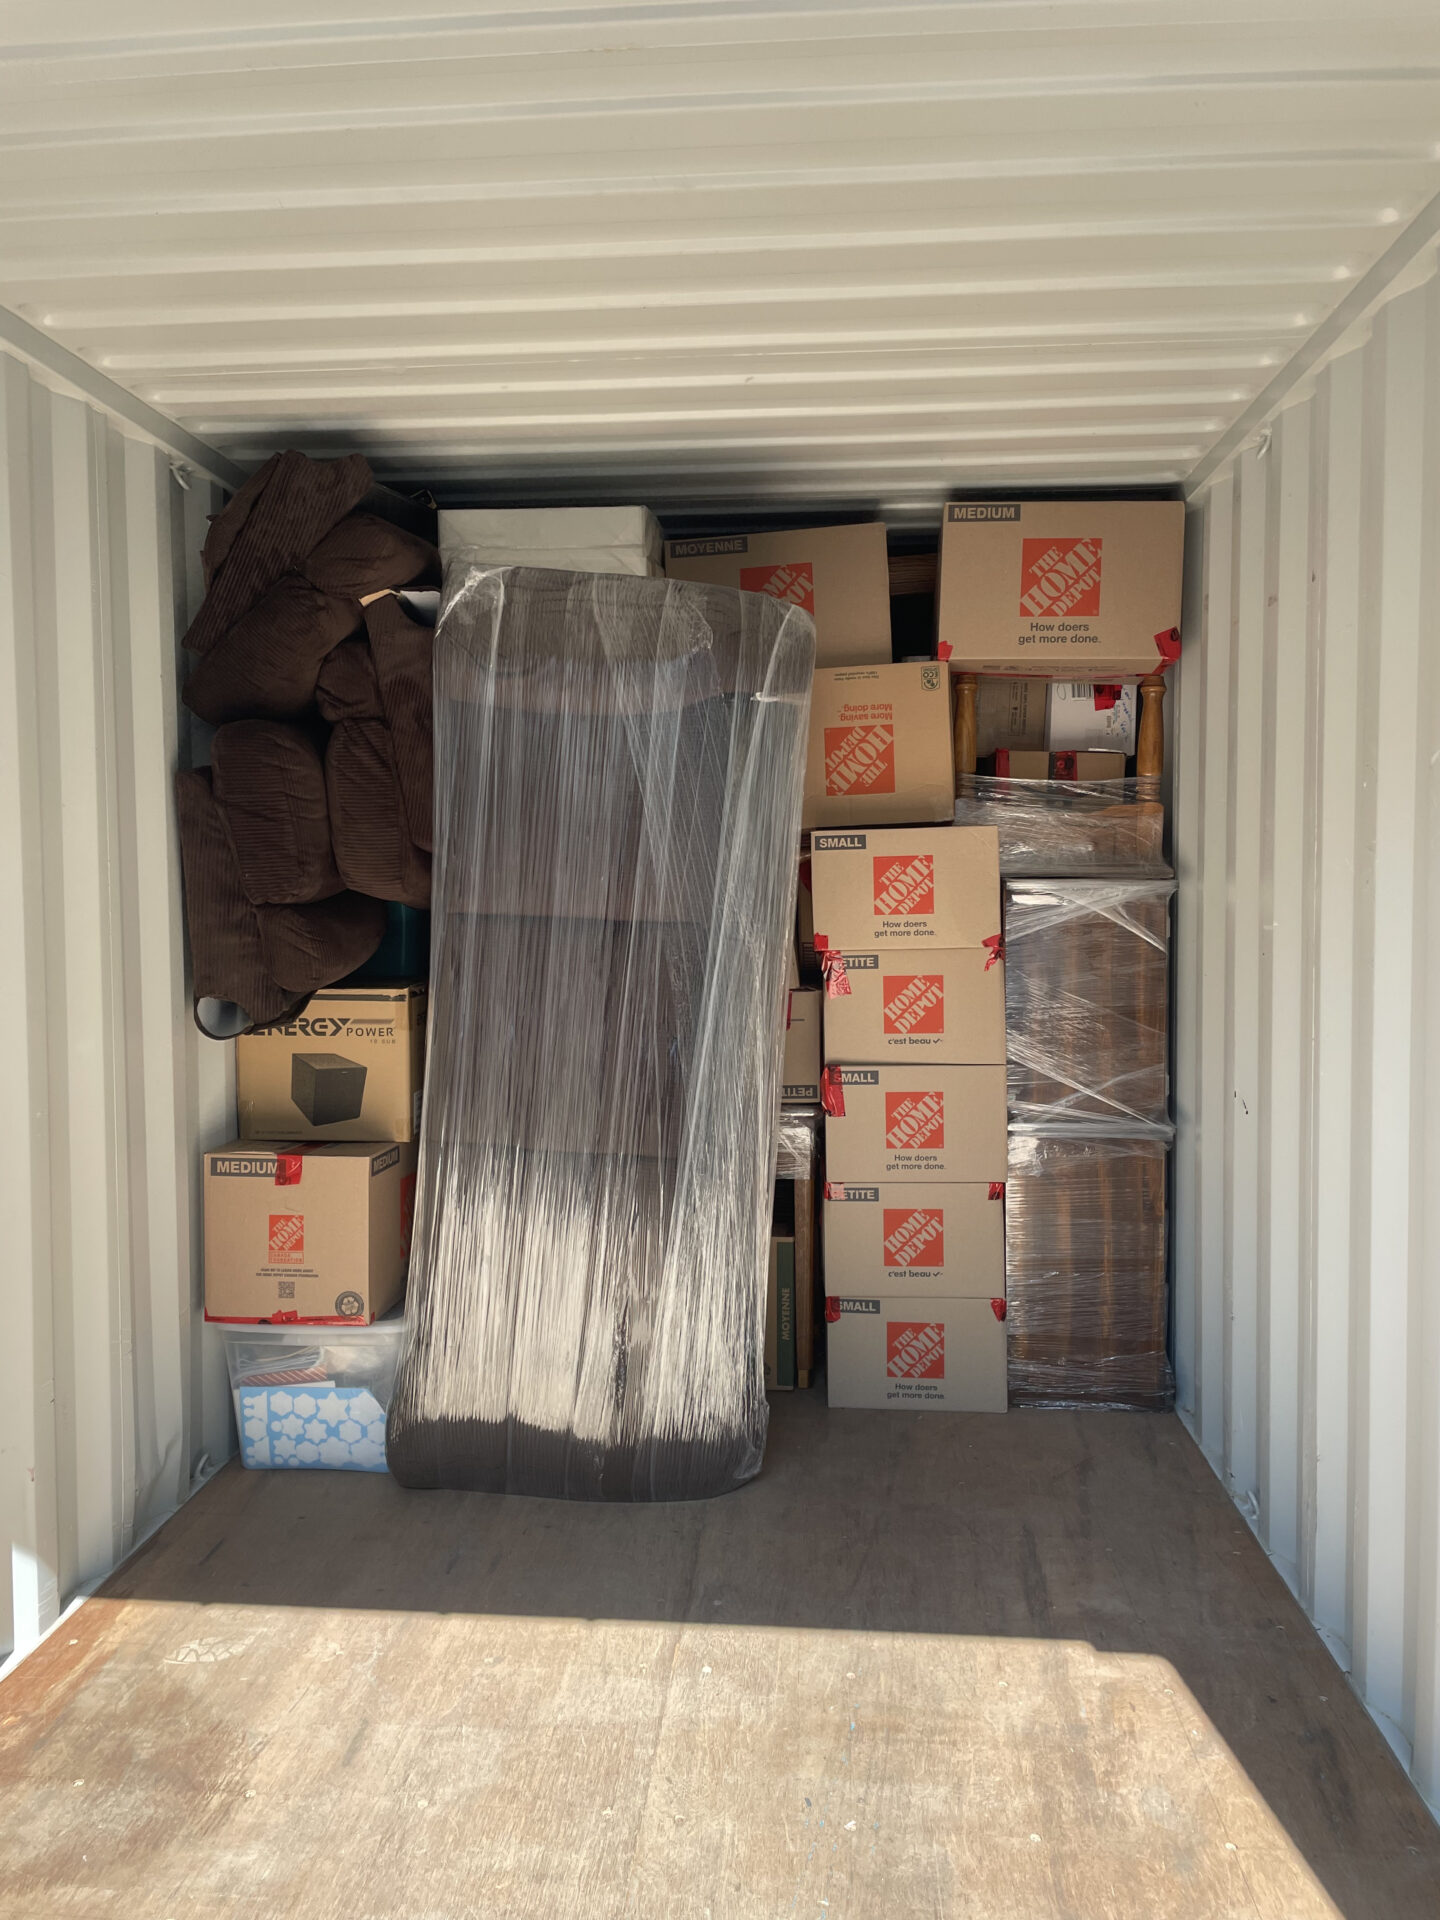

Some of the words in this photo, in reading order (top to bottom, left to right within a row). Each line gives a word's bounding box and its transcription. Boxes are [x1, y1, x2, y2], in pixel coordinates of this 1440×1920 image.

[954, 507, 1015, 519] MEDIUM
[675, 539, 743, 556] MOYENNE
[1028, 546, 1064, 578] THE
[762, 564, 797, 597] ME
[1020, 538, 1102, 617] HOME
[1050, 566, 1101, 617] DEPOT
[1030, 622, 1054, 632] How
[1058, 622, 1089, 632] doers
[1018, 635, 1037, 645] get
[1039, 635, 1068, 643] more
[871, 703, 892, 712] More
[871, 712, 892, 720] More
[826, 726, 866, 771] DEPOT
[826, 724, 894, 796] HOME
[860, 758, 888, 787] THE
[819, 837, 862, 848] SMALL
[874, 855, 934, 915] HOME
[879, 862, 904, 886] THE
[897, 876, 934, 915] DEPOT
[874, 929, 888, 938] get
[903, 920, 927, 928] doers
[842, 957, 875, 967] ETITE
[884, 975, 930, 1021] HOME
[893, 982, 944, 1034] DEPOT
[347, 1028, 394, 1036] POWER
[782, 1087, 813, 1097] PETIT
[886, 1091, 944, 1149] HOME
[890, 1097, 916, 1120] THE
[909, 1112, 944, 1149] DEPOT
[216, 1161, 280, 1174] MEDIUM
[373, 1149, 399, 1172] MEDIUM
[886, 1163, 899, 1171] get
[843, 1190, 875, 1200] ETITE
[269, 1215, 304, 1250] HOME
[272, 1219, 286, 1232] THE
[884, 1208, 930, 1254] HOME
[283, 1229, 304, 1250] DEPOT
[893, 1216, 944, 1267] DEPOT
[782, 1288, 790, 1341] MOYENNE
[887, 1321, 945, 1378] HOME
[892, 1328, 917, 1349] THE
[909, 1344, 944, 1378] DEPOT
[895, 1383, 913, 1391] How
[915, 1383, 938, 1391] doers
